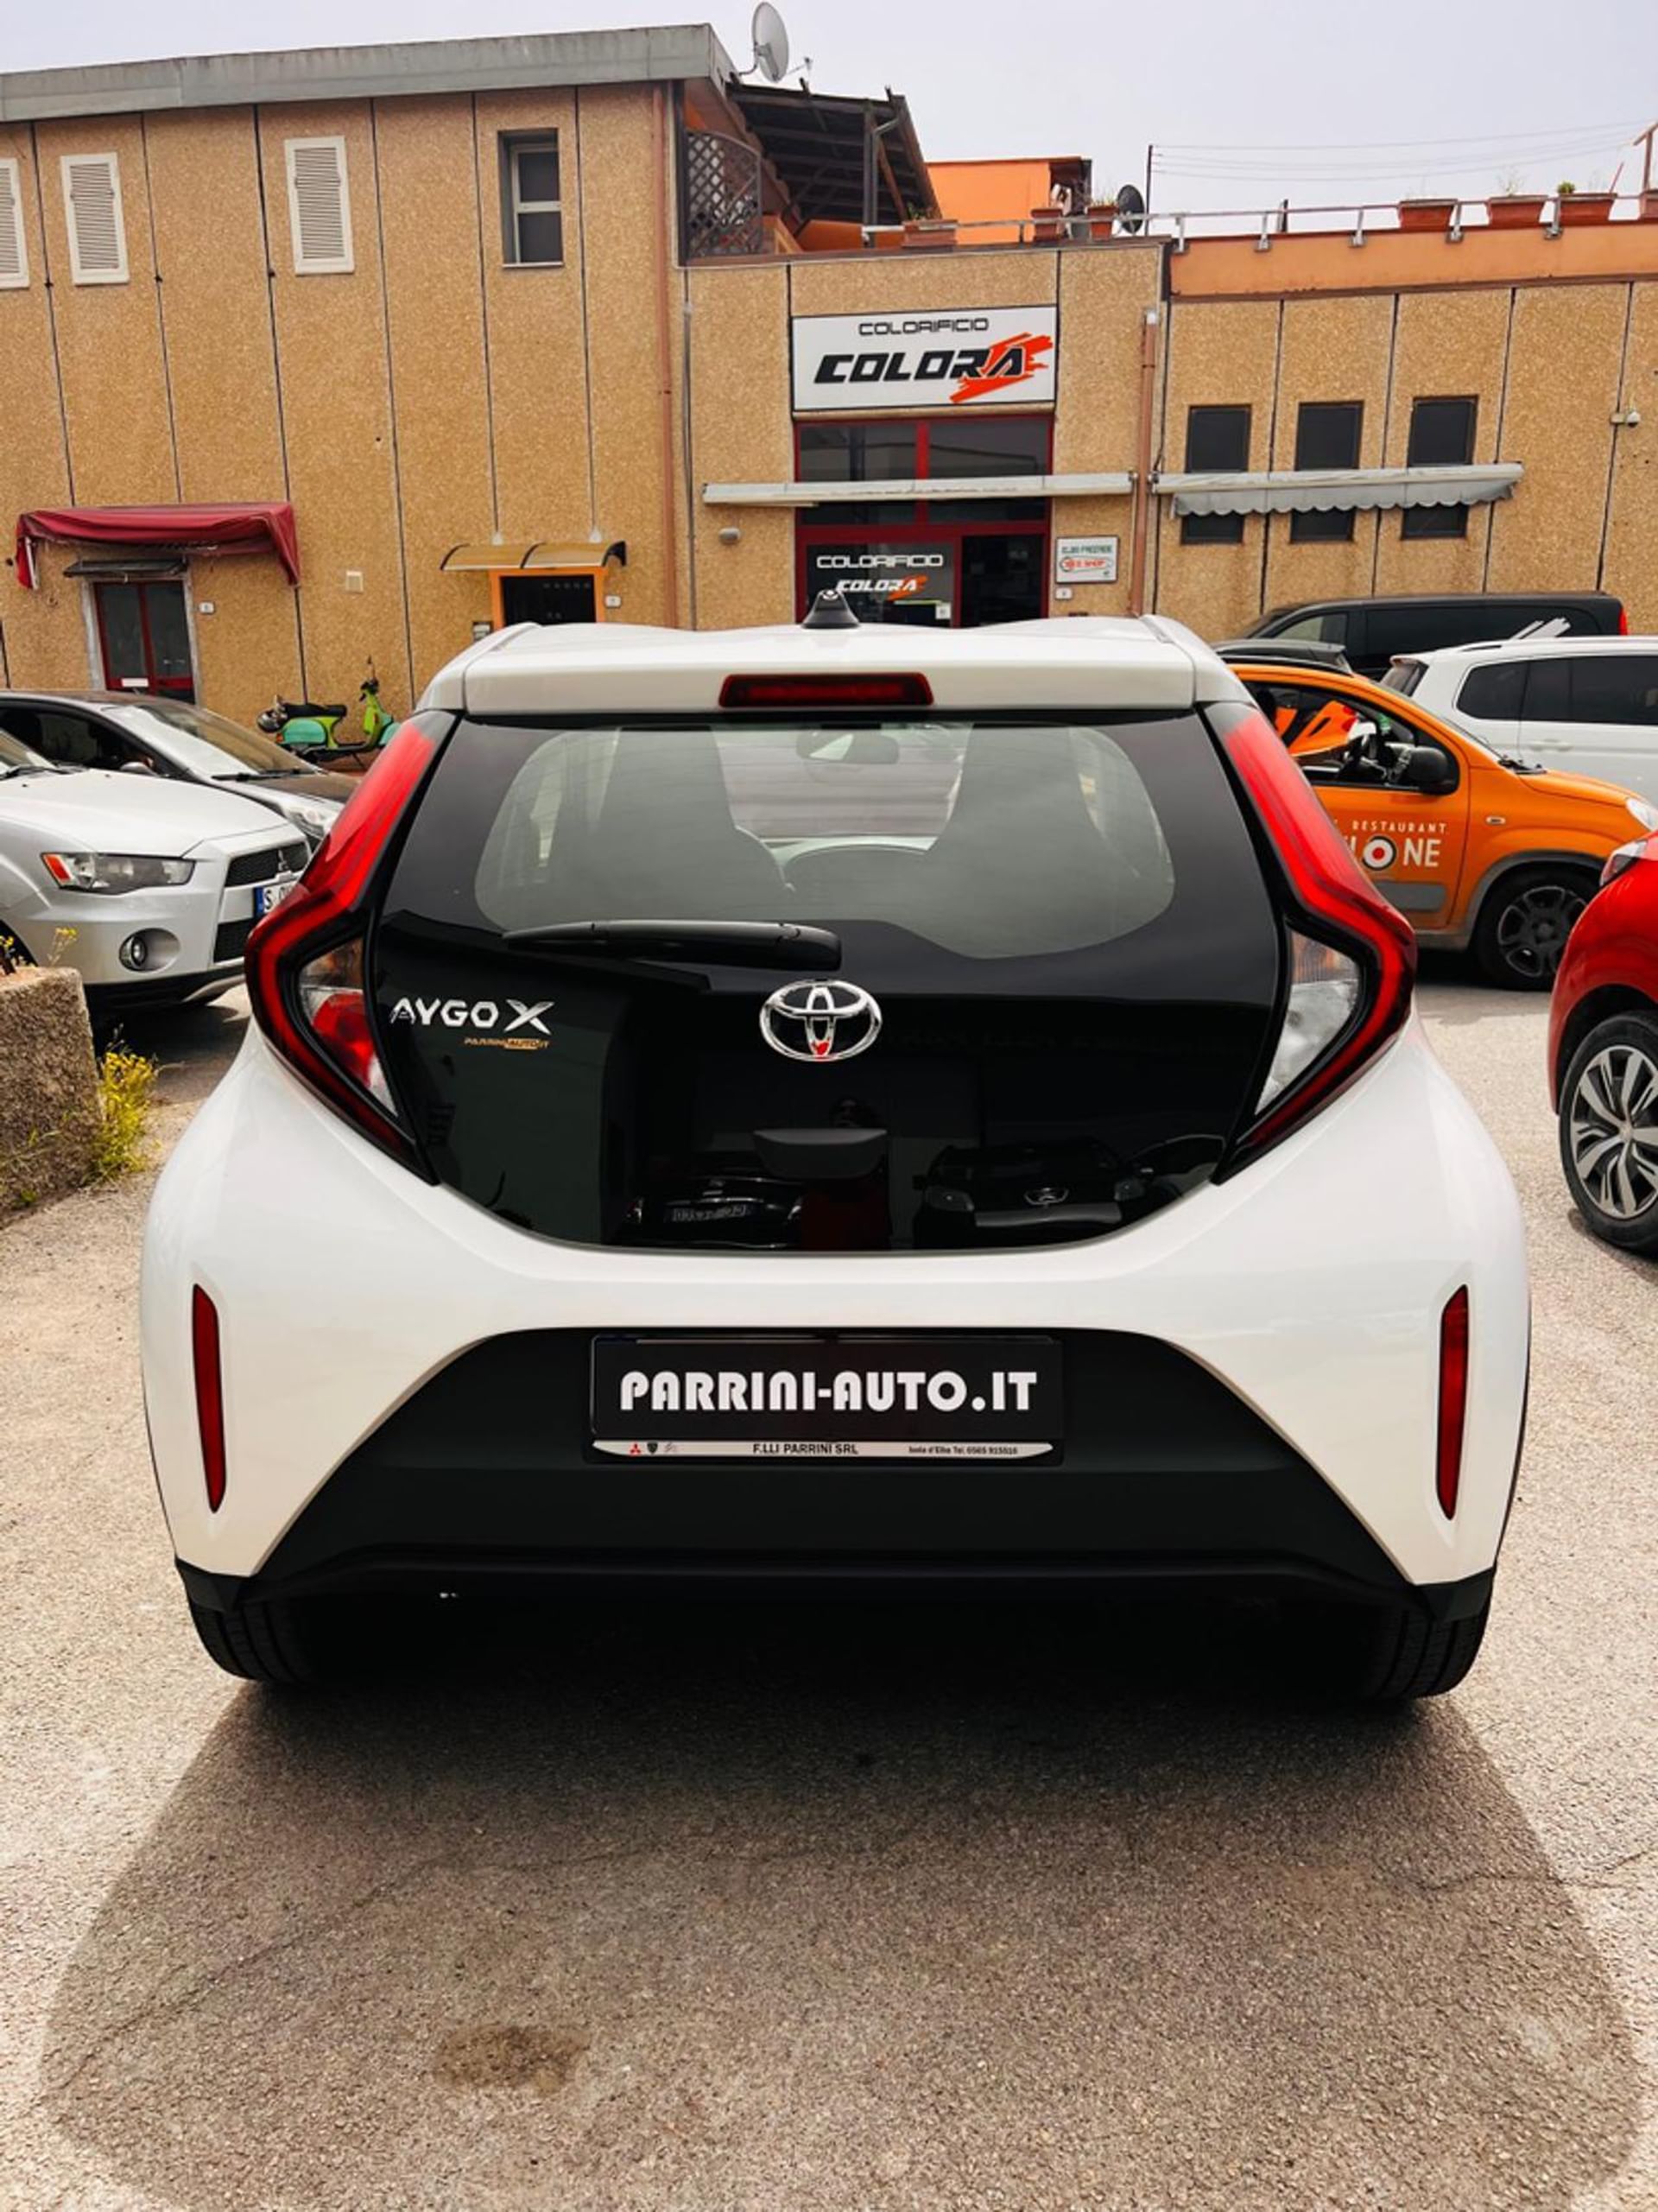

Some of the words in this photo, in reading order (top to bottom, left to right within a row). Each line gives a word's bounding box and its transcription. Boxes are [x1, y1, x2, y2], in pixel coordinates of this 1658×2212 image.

[857, 317, 990, 336] COLORIFICIO
[813, 346, 1026, 384] COLORA
[816, 554, 944, 569] COLORIFICIO
[835, 579, 918, 593] COLORA
[1351, 820, 1447, 834] RESTAURANT
[389, 997, 499, 1029] AYGO
[503, 998, 555, 1036] X
[619, 1370, 1038, 1412] PARRINI-AUTO.IT
[752, 1442, 780, 1455] F.LLI
[783, 1442, 832, 1455] PARRINI
[835, 1442, 859, 1455] SRL
